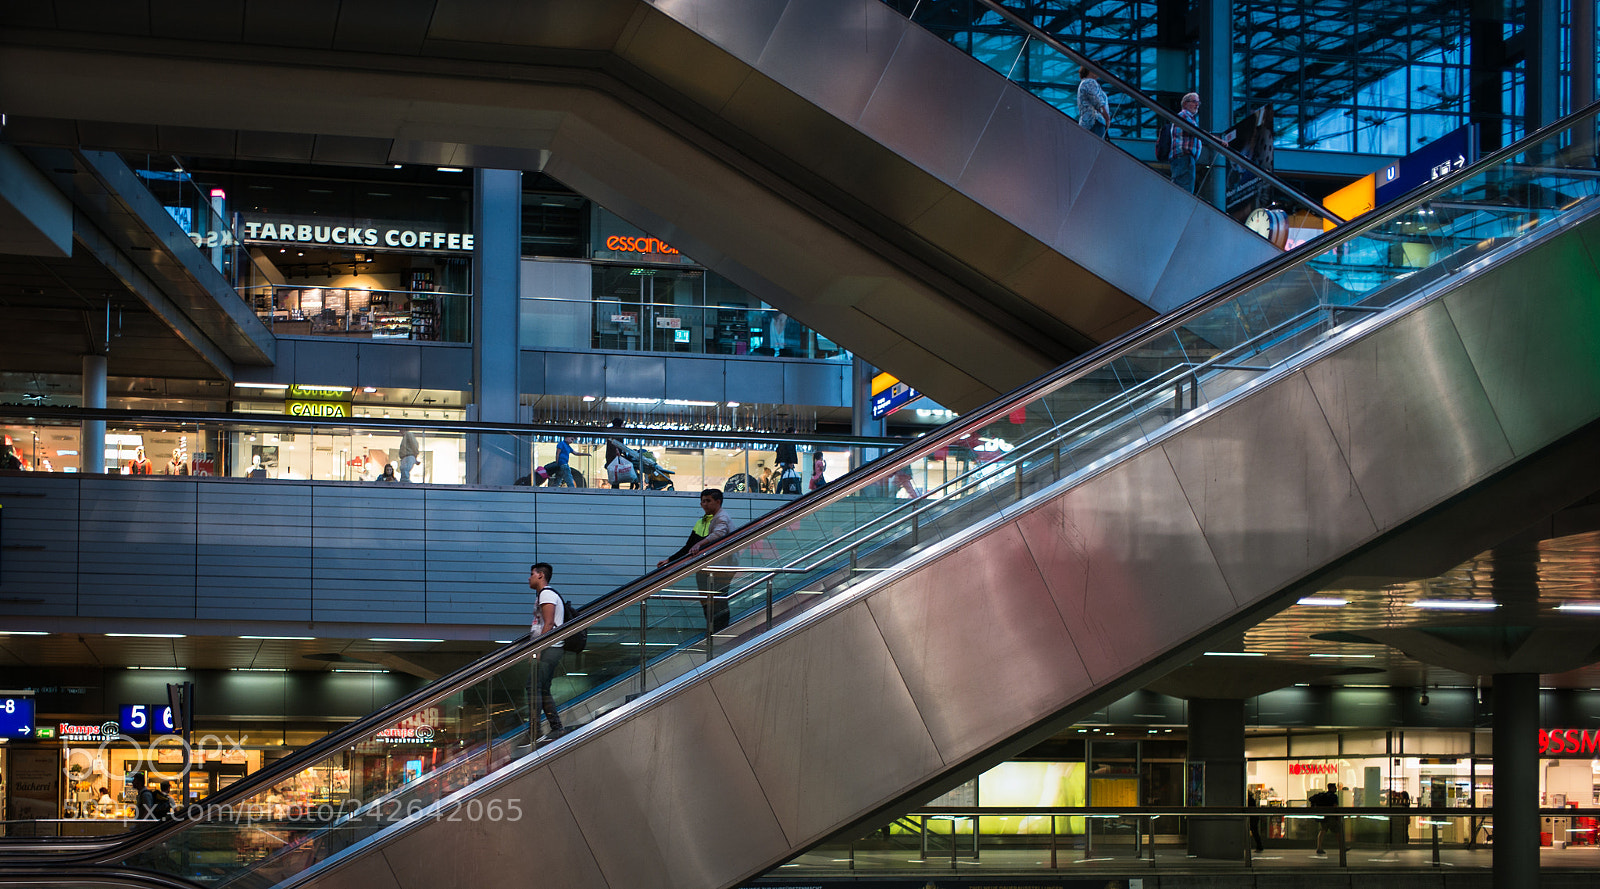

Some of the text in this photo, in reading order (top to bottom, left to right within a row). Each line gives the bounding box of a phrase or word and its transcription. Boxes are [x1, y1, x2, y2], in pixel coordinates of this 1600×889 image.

[1387, 166, 1395, 179] U
[244, 221, 474, 250] TARBUCKS COFFEE
[606, 235, 679, 254] essane
[291, 402, 346, 417] CALIDA
[130, 704, 146, 728] 5
[59, 722, 101, 736] Kamps
[1288, 763, 1338, 775] ROSSMANN
